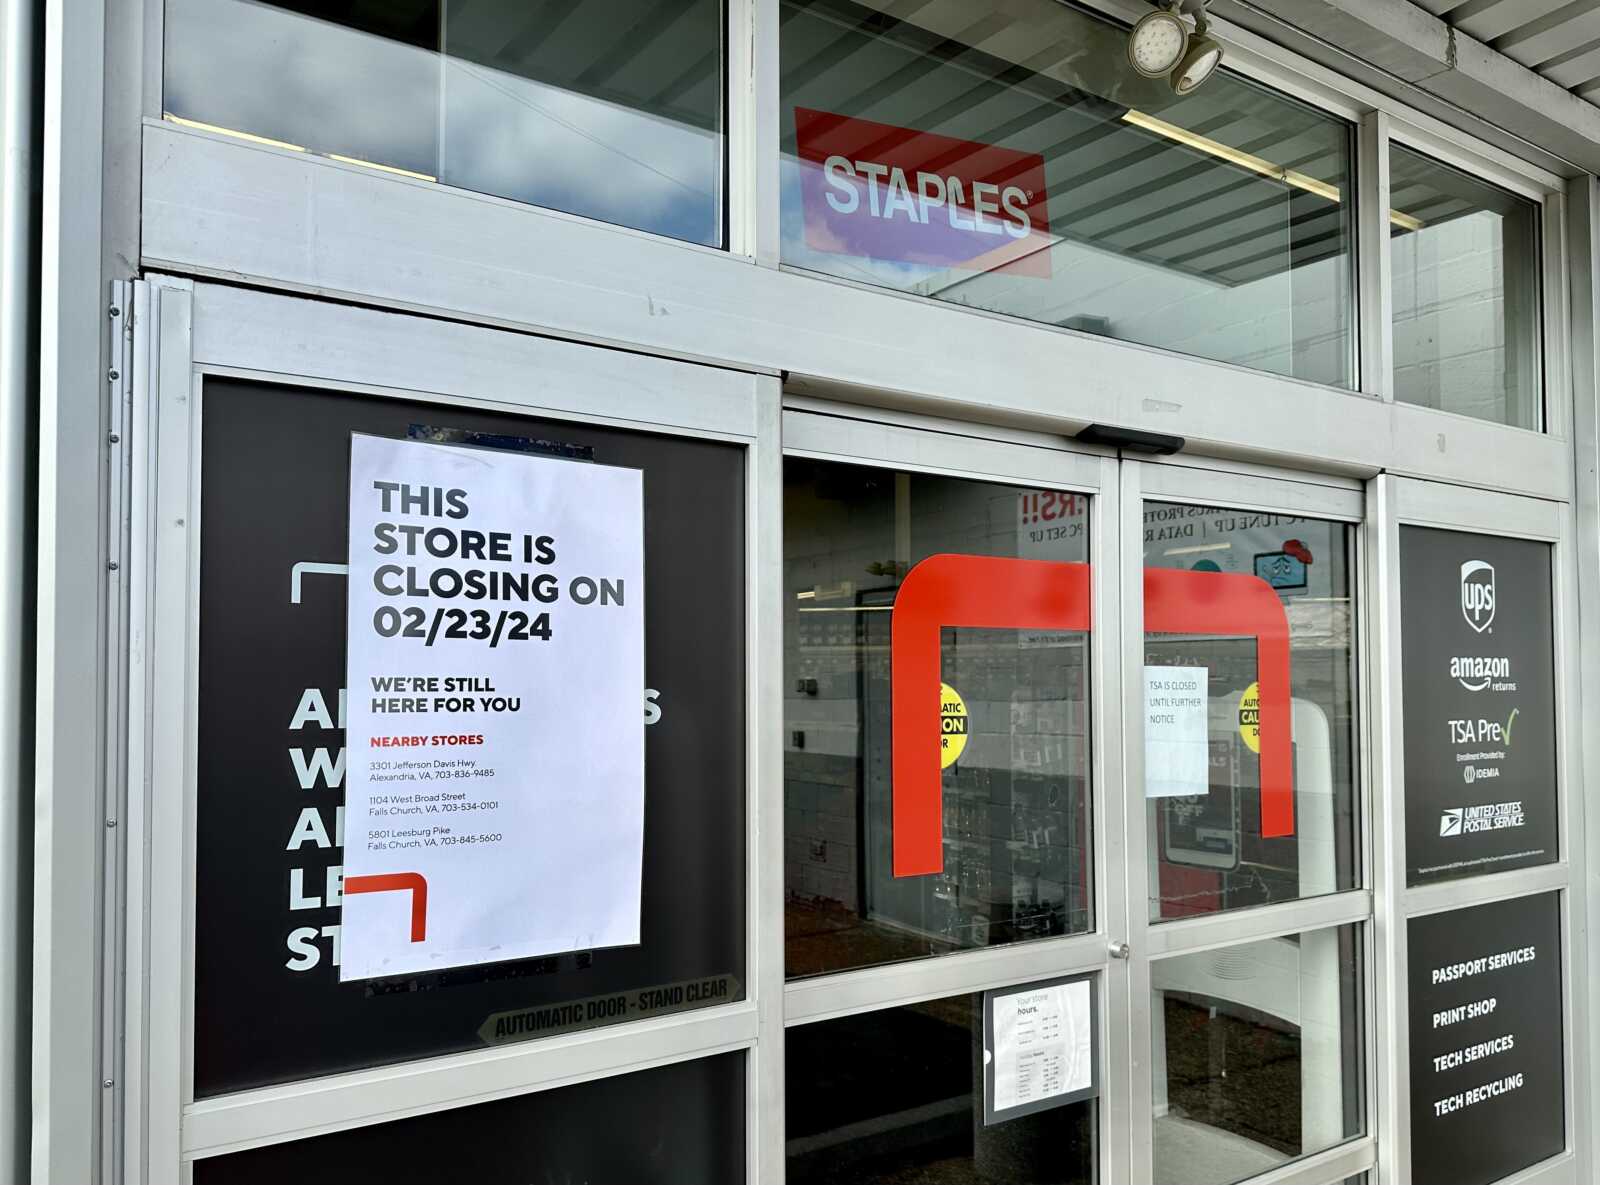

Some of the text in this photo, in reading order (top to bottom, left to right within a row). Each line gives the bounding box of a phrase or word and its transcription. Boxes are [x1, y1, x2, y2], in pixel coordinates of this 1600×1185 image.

[823, 155, 1031, 239] STAPLES
[373, 480, 469, 519] THIS
[373, 522, 556, 565] STORE IS
[373, 564, 625, 606] CLOSING ON
[1463, 582, 1494, 621] ups
[373, 605, 552, 648] 02/23/24
[1450, 656, 1510, 679] amazon
[371, 676, 496, 692] WE'RE STILL
[1150, 680, 1197, 690] TSA IS CLOSED
[1492, 682, 1517, 691] returns
[371, 697, 521, 713] HERE FOR YOU
[942, 703, 961, 713] ATIC
[1150, 698, 1201, 708] UNTIL FURTHER
[942, 718, 964, 733] ON
[1150, 714, 1175, 724] NOTICE
[1448, 720, 1476, 744] TSA
[371, 734, 484, 748] NEARBY STORES
[370, 761, 391, 770] 3301
[393, 761, 432, 770] Jefferson
[434, 760, 456, 768] Davis
[370, 768, 495, 782] Alexandria, VA, 703-836-9485
[370, 792, 466, 805] 1104 West Broad Street
[369, 801, 499, 816] Falls Church, VA, 703-534-0101
[1464, 801, 1522, 819] UNITED STATES
[1463, 812, 1526, 833] POSTAL SERVICE
[368, 826, 451, 839] 5801 Leesburg Pike
[368, 833, 503, 850] Falls Church, VA, 703-845-5600
[1432, 946, 1535, 984] PASSPORT SERVICES
[495, 1006, 584, 1038] AUTOMATIC
[587, 996, 627, 1021] DOOR
[639, 986, 683, 1011] STAND
[687, 979, 727, 1003] CLEAR
[1433, 998, 1497, 1028] PRINT SHOP
[1433, 1034, 1514, 1073] TECH SERVICES
[1434, 1073, 1524, 1117] TECH RECYCLING
